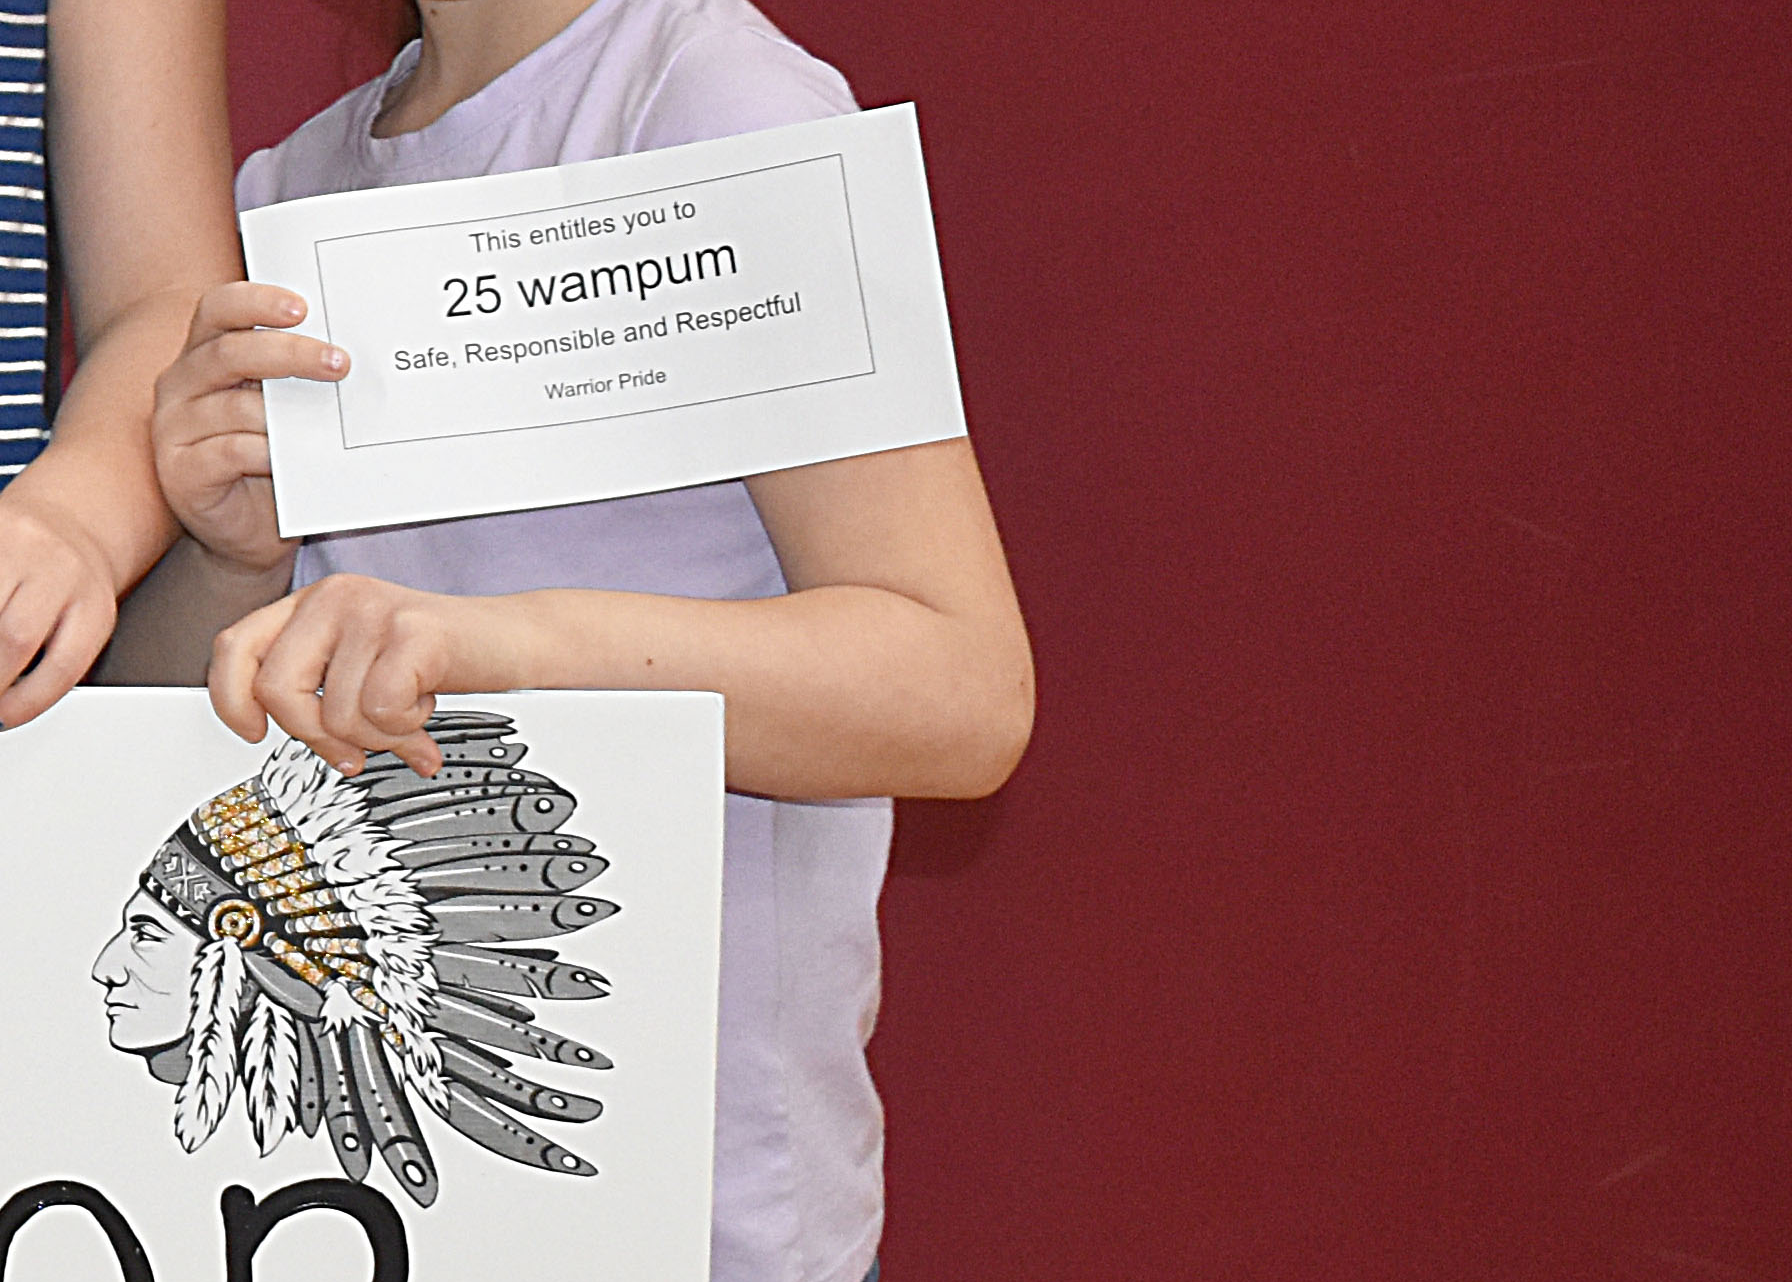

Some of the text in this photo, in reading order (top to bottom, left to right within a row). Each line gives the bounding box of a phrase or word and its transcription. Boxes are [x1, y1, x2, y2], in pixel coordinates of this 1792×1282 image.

[468, 201, 696, 252] This entitles you to
[443, 245, 737, 318] 25 wampum
[394, 291, 802, 371] Safe, Responsible and Respectful
[545, 369, 667, 400] Warrior Pride
